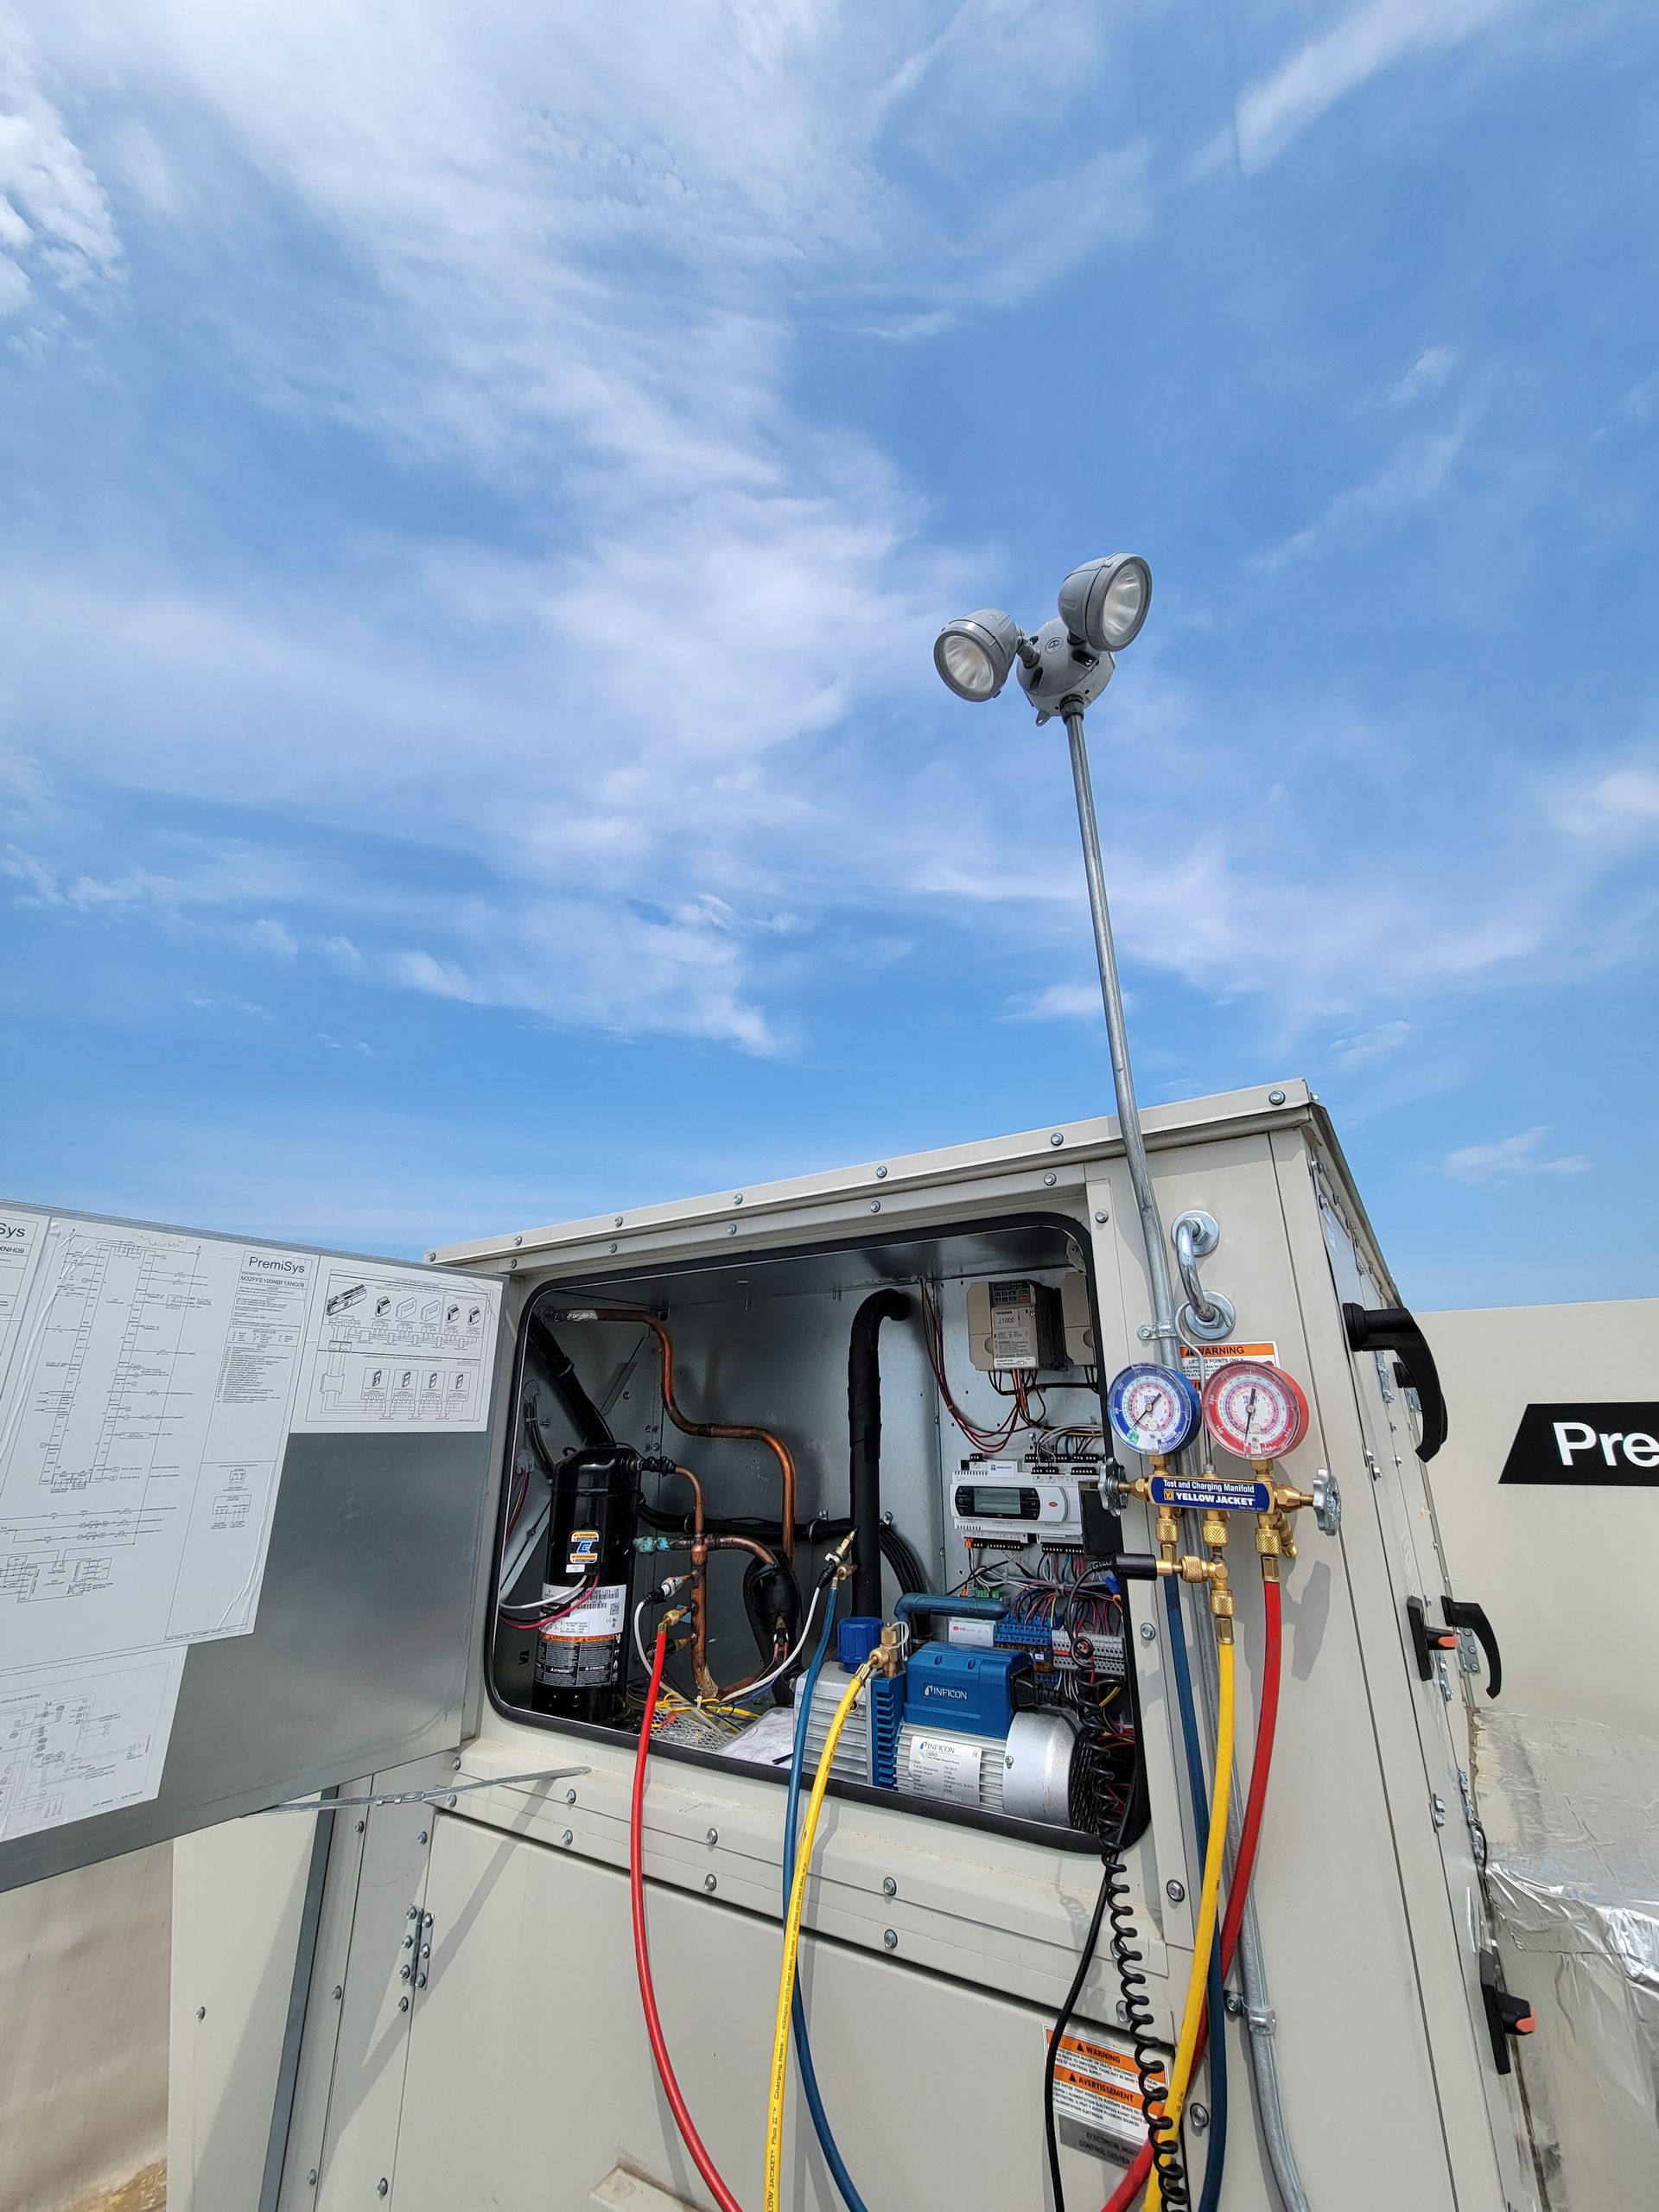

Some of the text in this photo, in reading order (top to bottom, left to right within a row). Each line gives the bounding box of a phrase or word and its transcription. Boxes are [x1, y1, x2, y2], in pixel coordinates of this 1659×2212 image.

[249, 1256, 305, 1274] PremiSys
[1215, 1425, 1224, 1434] 100
[1553, 1422, 1659, 1468] Pre
[1164, 1479, 1177, 1488] Test
[1192, 1482, 1223, 1492] Charging
[1224, 1484, 1255, 1493] Manifold
[1176, 1492, 1214, 1503] YELLOW
[1215, 1496, 1254, 1506] JACKET
[933, 1688, 968, 1700] INFICON
[927, 1743, 956, 1754] INFICON
[1085, 2045, 1121, 2063] WARNING
[1078, 2075, 1134, 2101] AVERTISSEMENT
